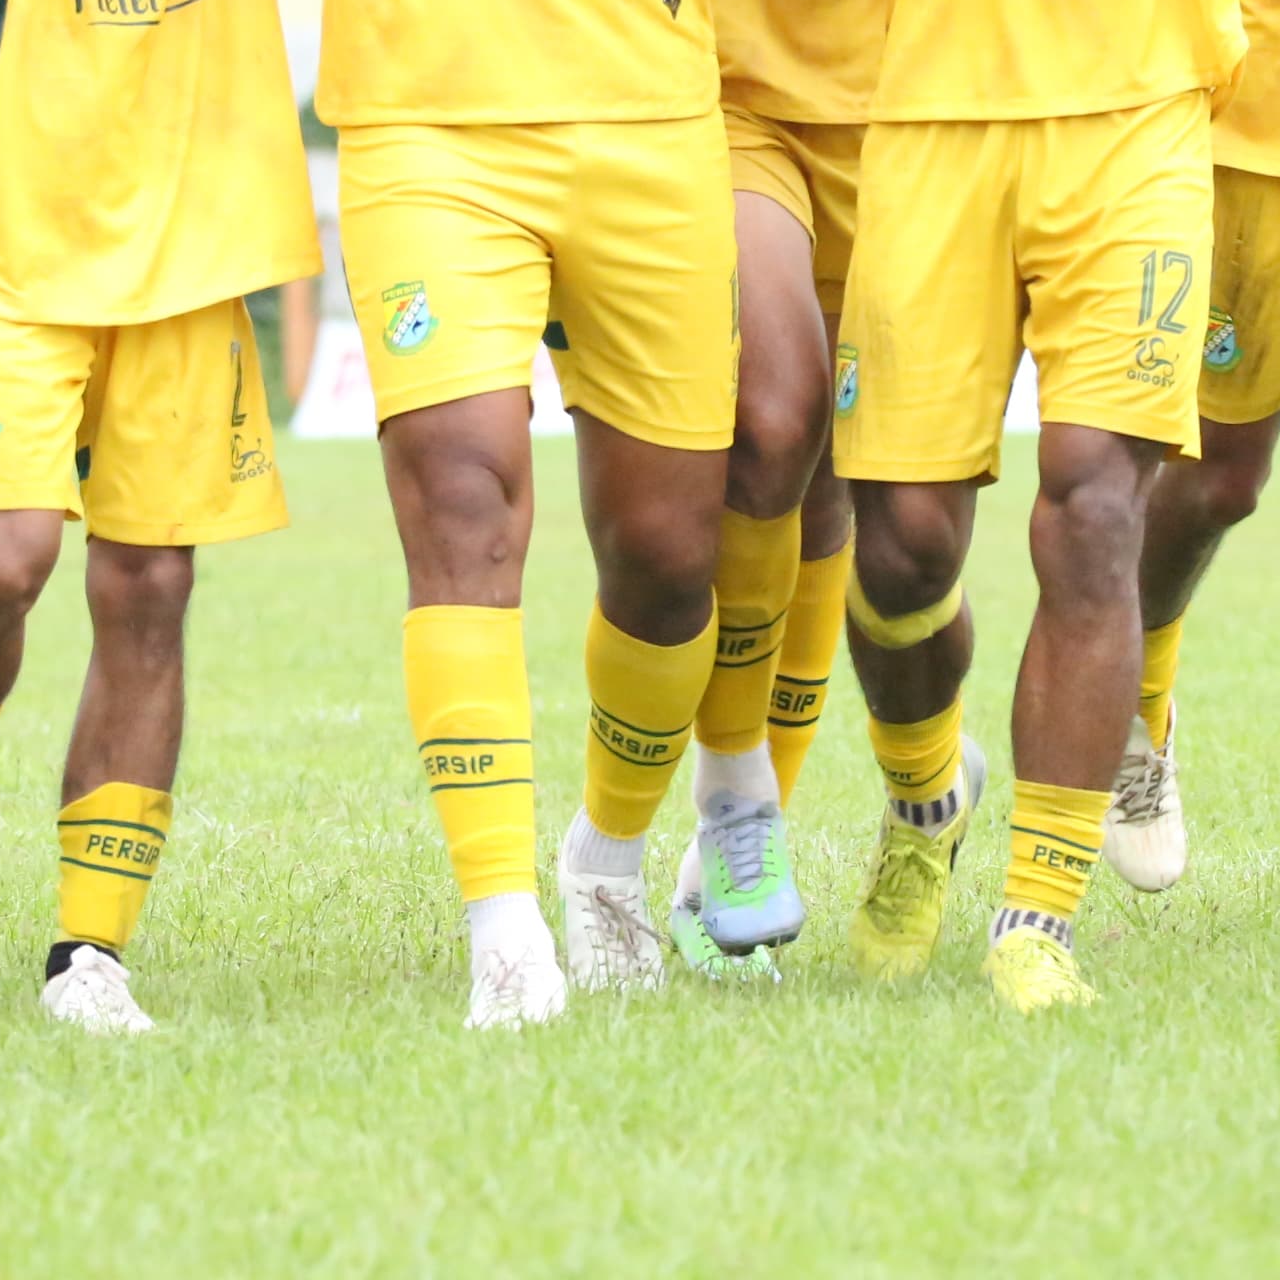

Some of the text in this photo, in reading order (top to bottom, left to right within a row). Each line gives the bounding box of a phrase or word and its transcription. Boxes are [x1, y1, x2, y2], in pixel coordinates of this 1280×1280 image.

[1138, 248, 1193, 335] 12
[1125, 368, 1177, 389] GIGGSY
[85, 833, 161, 866] PERSIP
